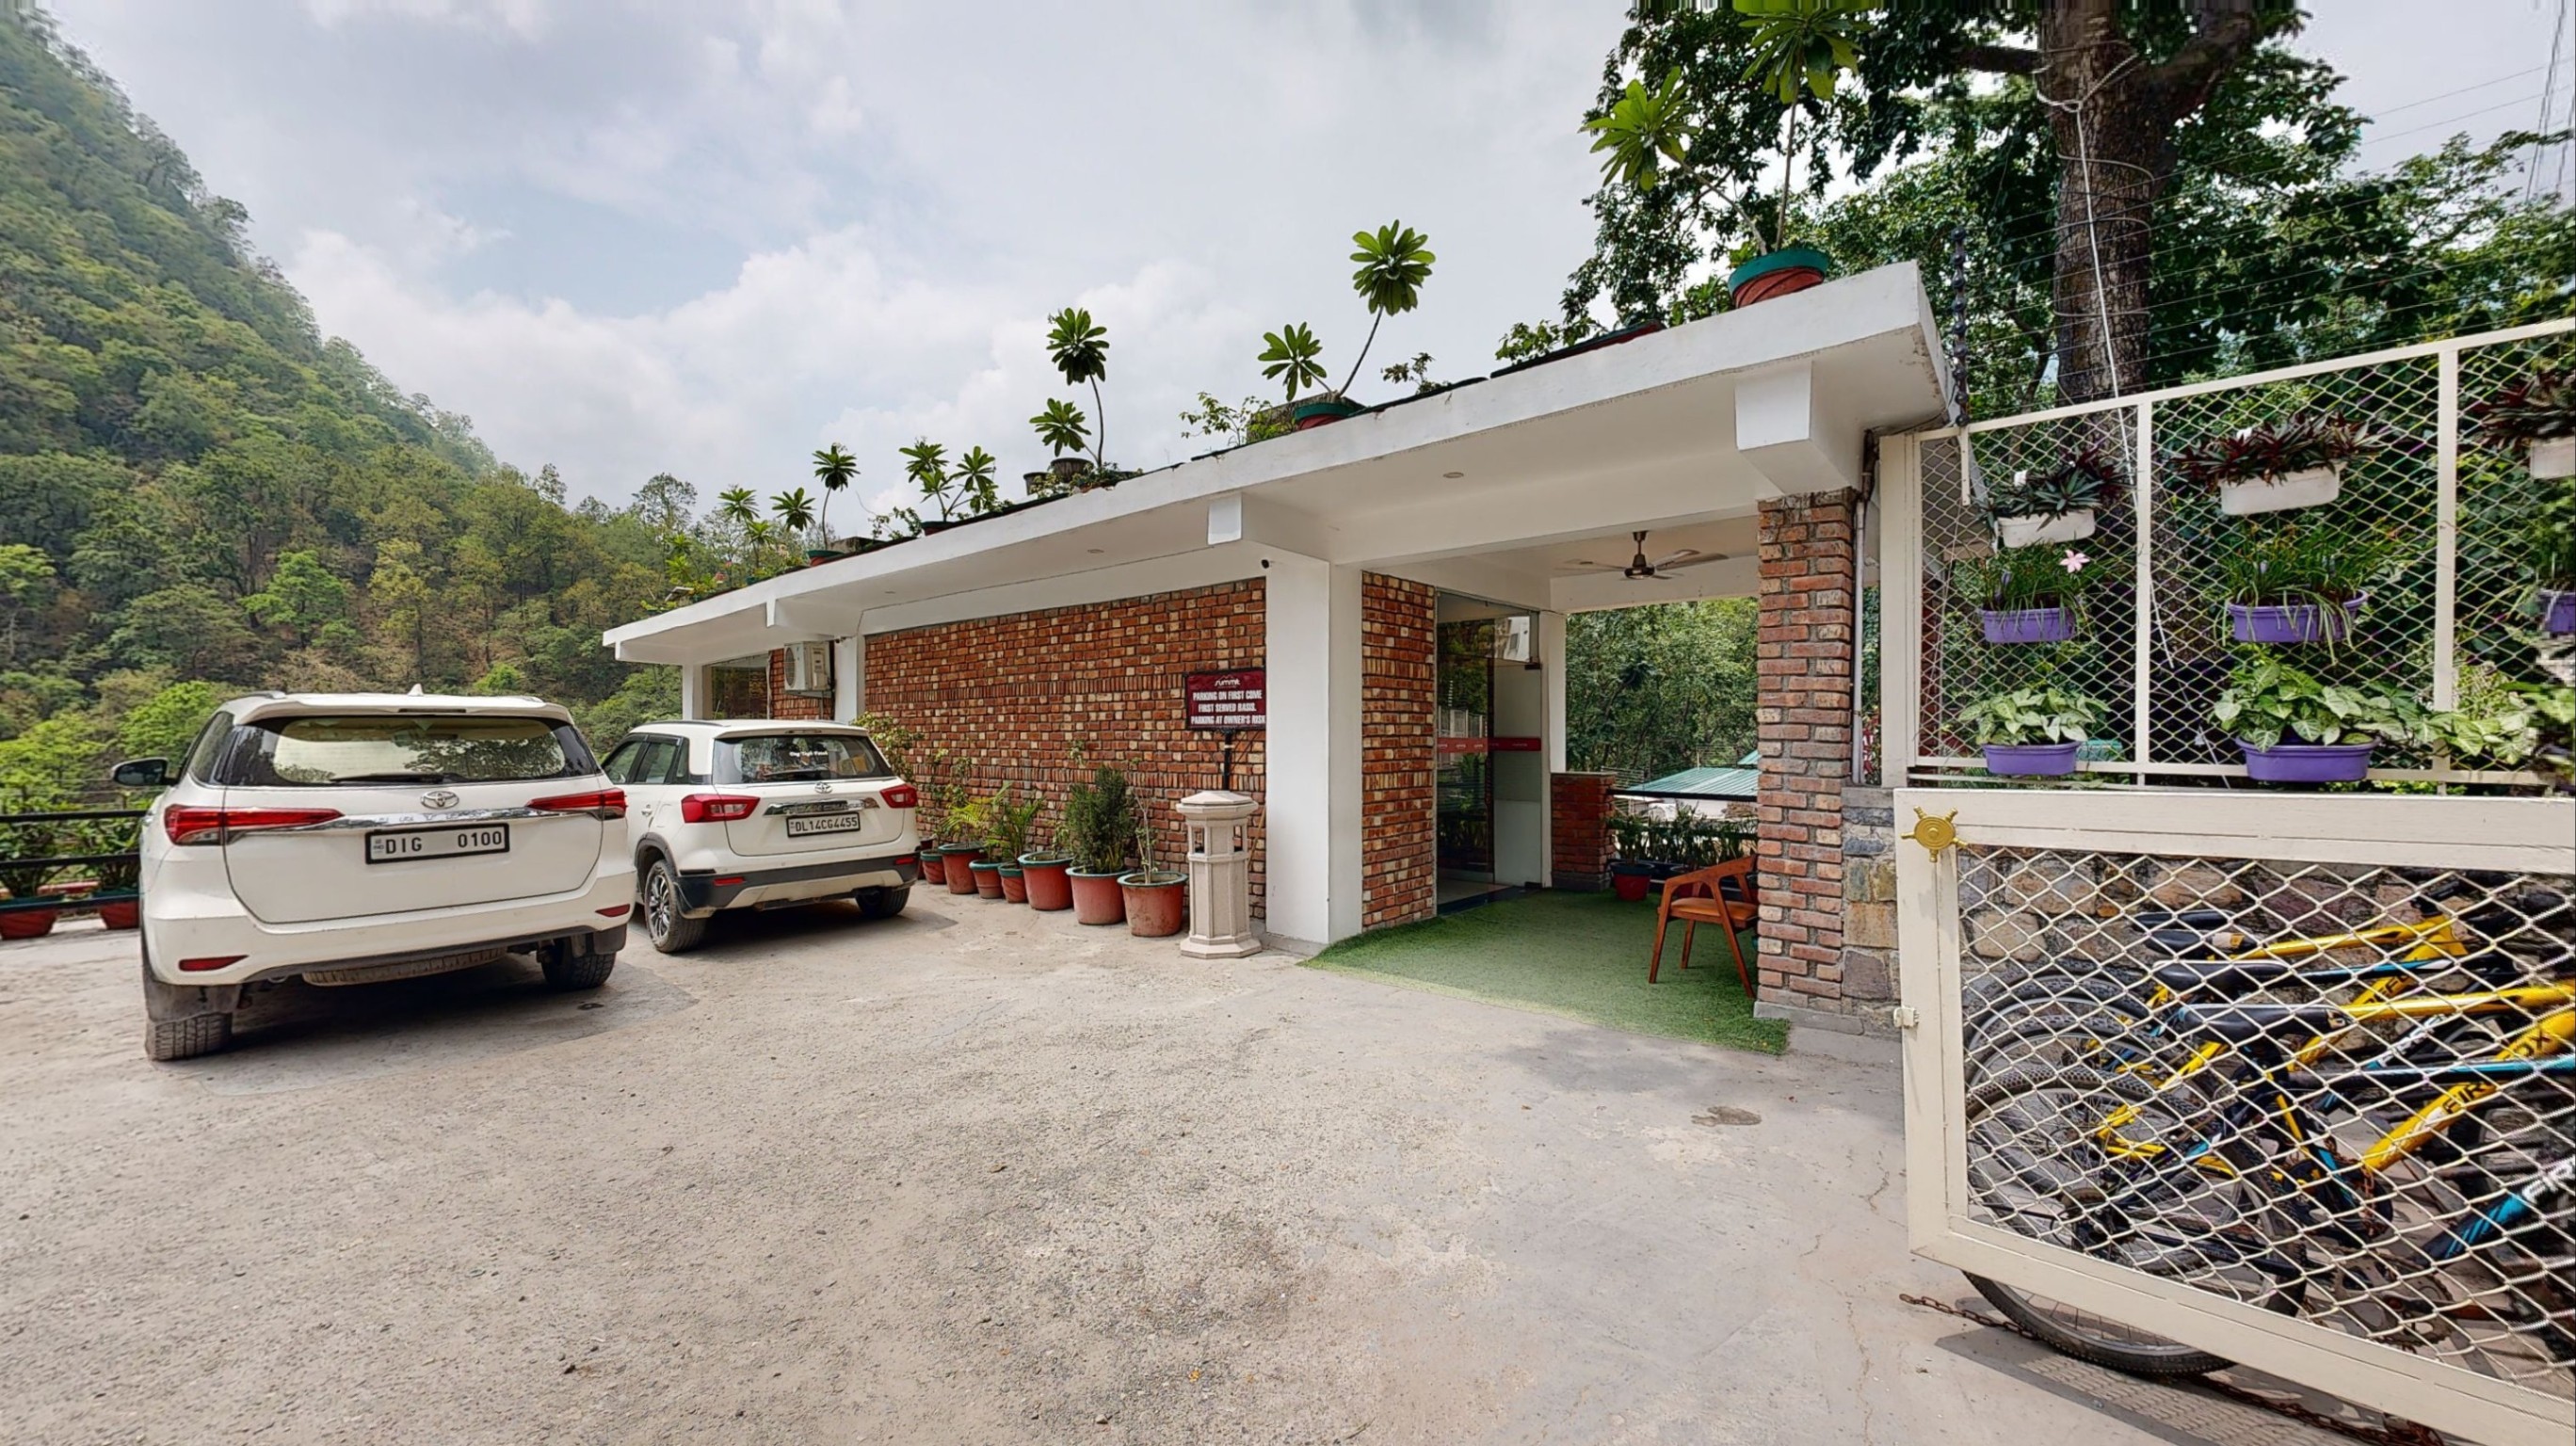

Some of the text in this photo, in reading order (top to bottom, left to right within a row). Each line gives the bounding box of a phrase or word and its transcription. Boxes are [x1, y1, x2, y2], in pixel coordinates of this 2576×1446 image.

[1193, 690, 1262, 701] PARKING ON FIRST COME
[1199, 703, 1214, 713] FIRST
[1216, 703, 1236, 713] SERVED
[1191, 715, 1215, 725] PARKING
[1216, 715, 1223, 724] AT
[1224, 715, 1250, 724] OWNER'S
[796, 817, 858, 832] DL14CG4455
[386, 830, 502, 854] DIG 0100
